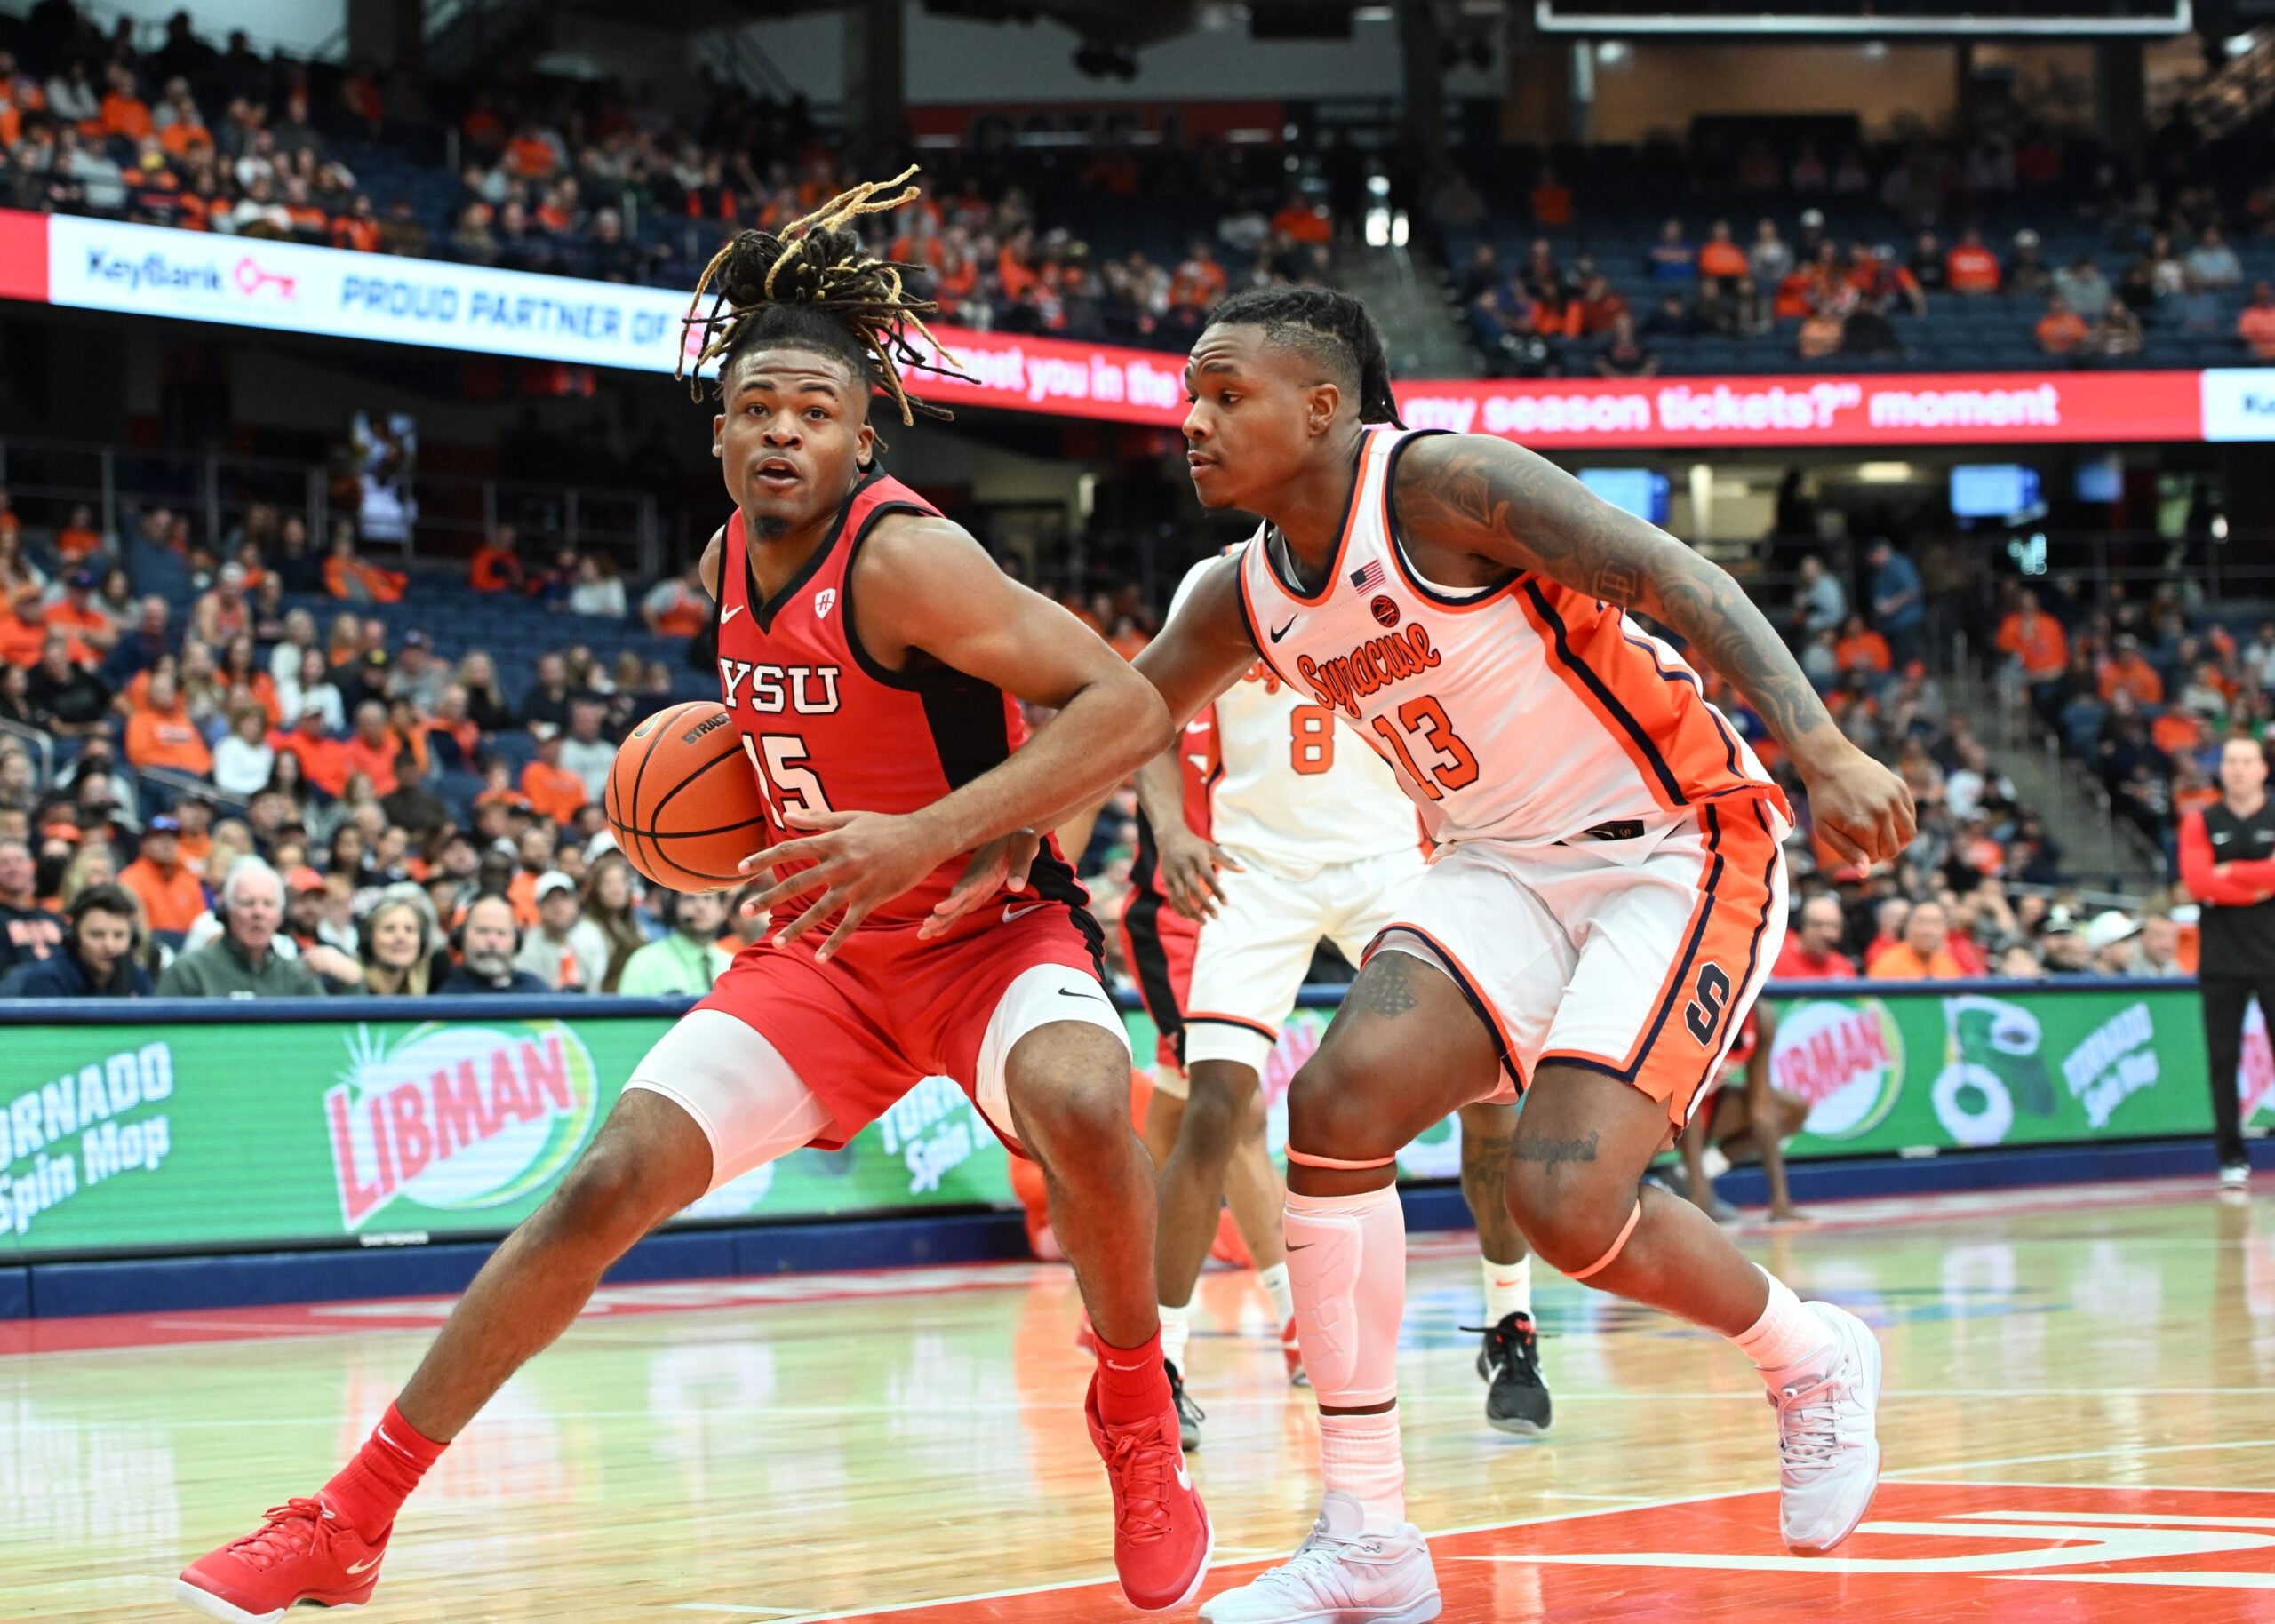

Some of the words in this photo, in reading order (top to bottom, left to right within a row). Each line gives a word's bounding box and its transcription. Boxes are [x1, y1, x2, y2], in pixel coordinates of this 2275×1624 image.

[86, 250, 221, 291] KeyBank
[341, 274, 459, 322] PROUD
[470, 291, 621, 339] PARTNER
[630, 309, 671, 346] OF
[1026, 357, 1090, 403] you
[1090, 353, 1124, 402] in
[1125, 358, 1179, 410] the
[1402, 396, 1478, 434] my
[1482, 394, 1652, 434] season
[1869, 381, 2061, 428] moment
[720, 656, 842, 714] YSU
[1297, 622, 1441, 720] Syracuse
[682, 712, 731, 744] SYRAC
[1290, 704, 1335, 776] 8
[1370, 693, 1480, 801] 13
[740, 731, 835, 832] 15
[327, 1034, 572, 1224] LIBMAN
[0, 1151, 78, 1238] Spin
[81, 1114, 171, 1187] Mop
